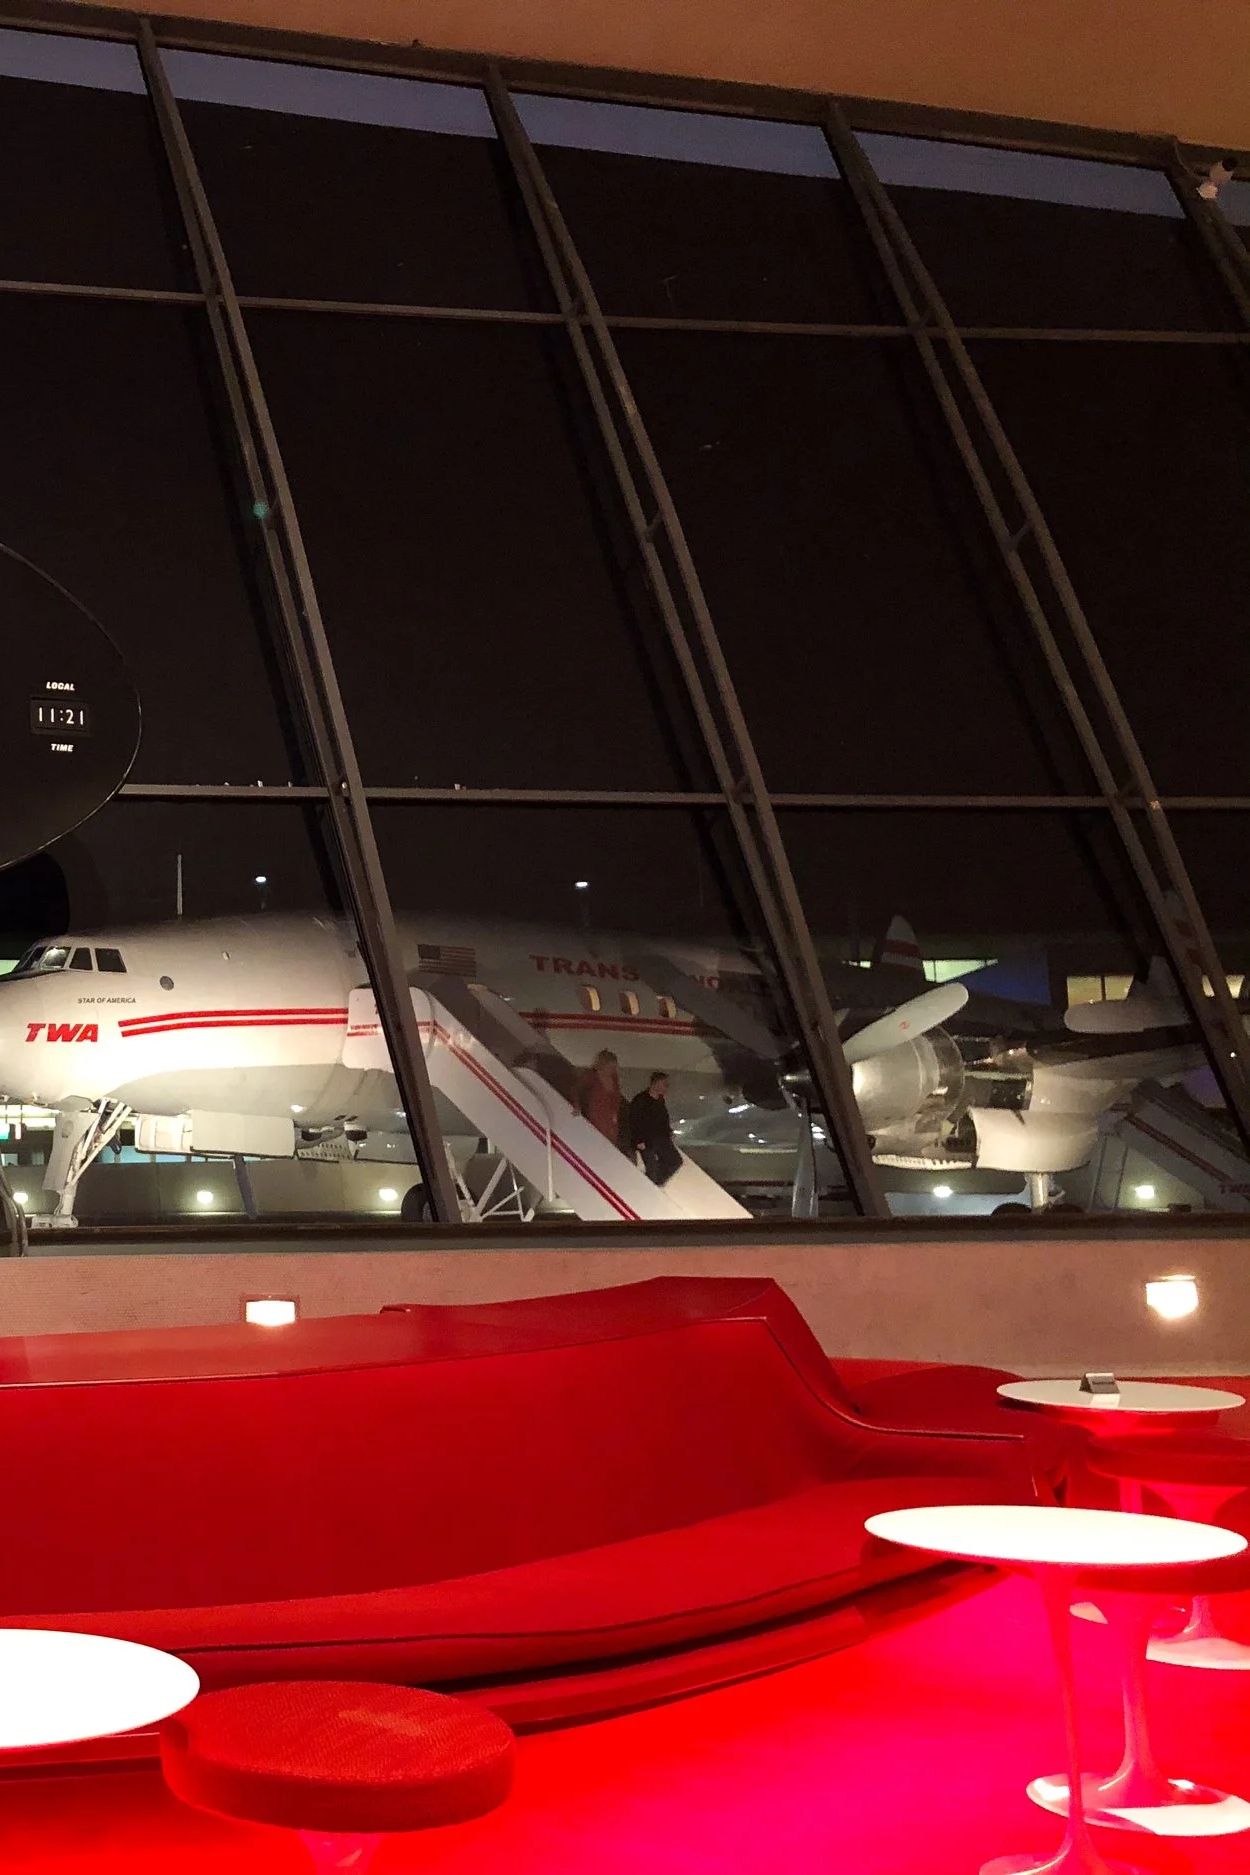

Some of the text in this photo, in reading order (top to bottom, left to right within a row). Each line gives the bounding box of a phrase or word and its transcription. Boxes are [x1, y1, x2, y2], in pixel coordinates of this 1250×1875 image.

[46, 681, 75, 691] LOCAL
[38, 706, 84, 725] 11:21
[51, 743, 74, 752] TIME
[528, 954, 640, 981] TRANS
[25, 1023, 99, 1042] TWA
